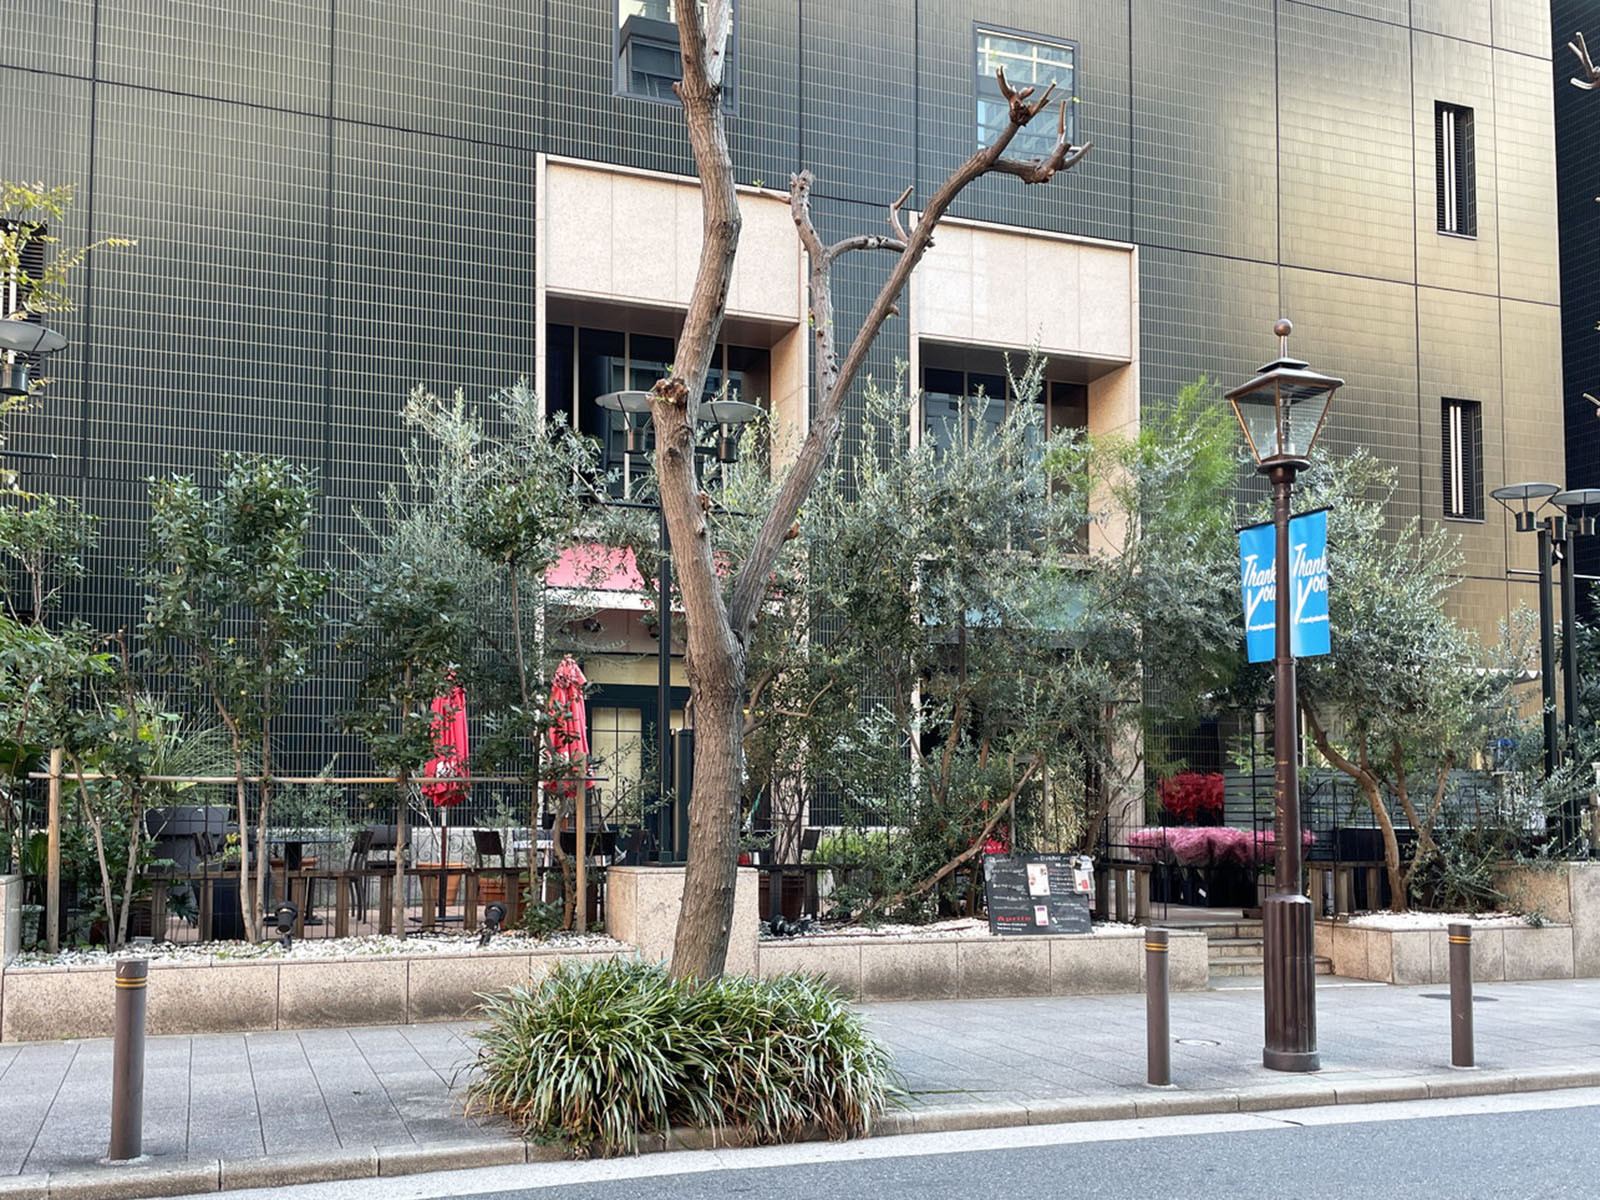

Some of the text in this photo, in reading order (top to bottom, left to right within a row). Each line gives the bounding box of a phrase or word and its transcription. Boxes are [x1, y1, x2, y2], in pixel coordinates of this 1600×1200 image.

[1244, 554, 1276, 587] Thank
[1294, 543, 1328, 577] Thank
[1296, 577, 1328, 625] You
